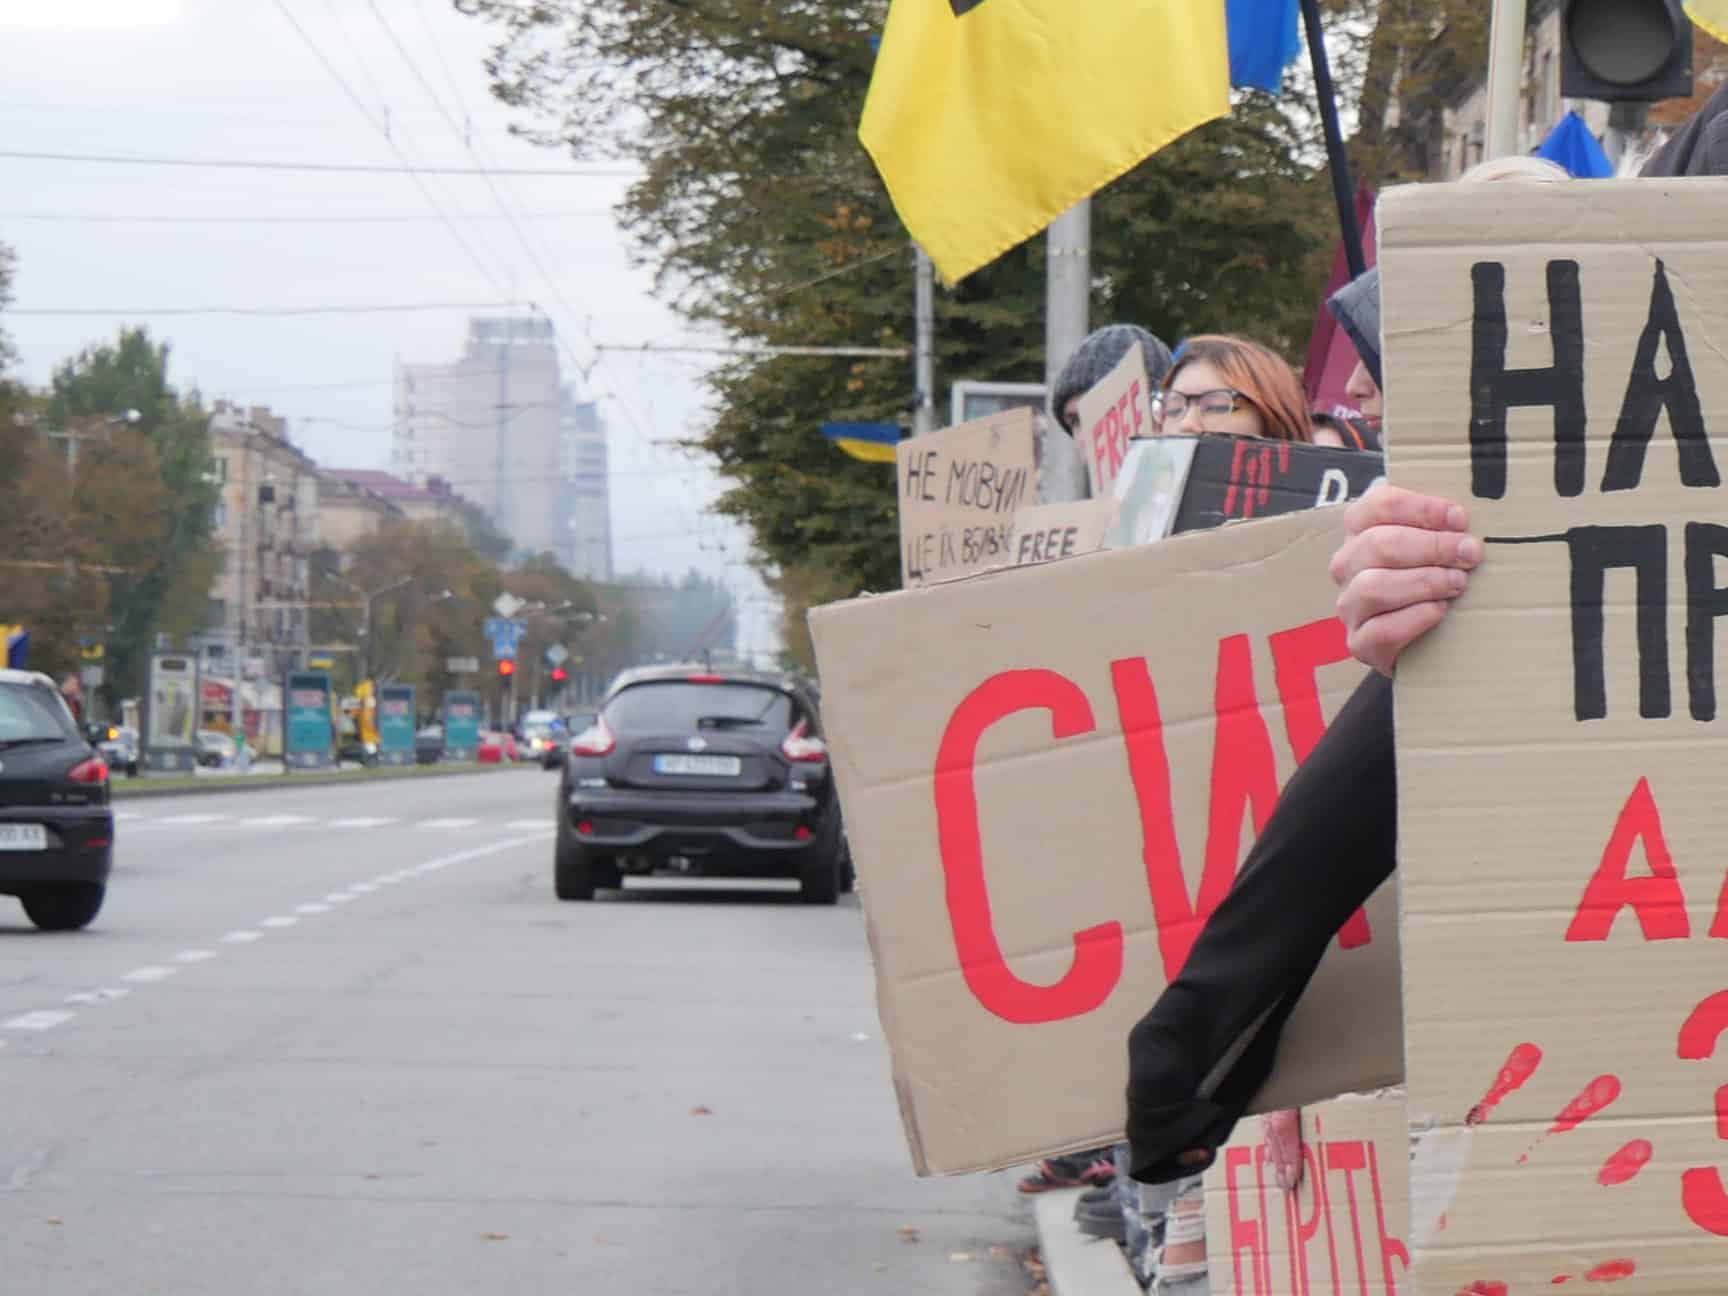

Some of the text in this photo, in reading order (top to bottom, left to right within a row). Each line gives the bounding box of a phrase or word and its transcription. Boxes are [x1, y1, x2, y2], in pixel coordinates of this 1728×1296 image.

[906, 449, 938, 502] НЕ
[907, 532, 933, 582] ЦЕ
[1015, 526, 1080, 564] FREE
